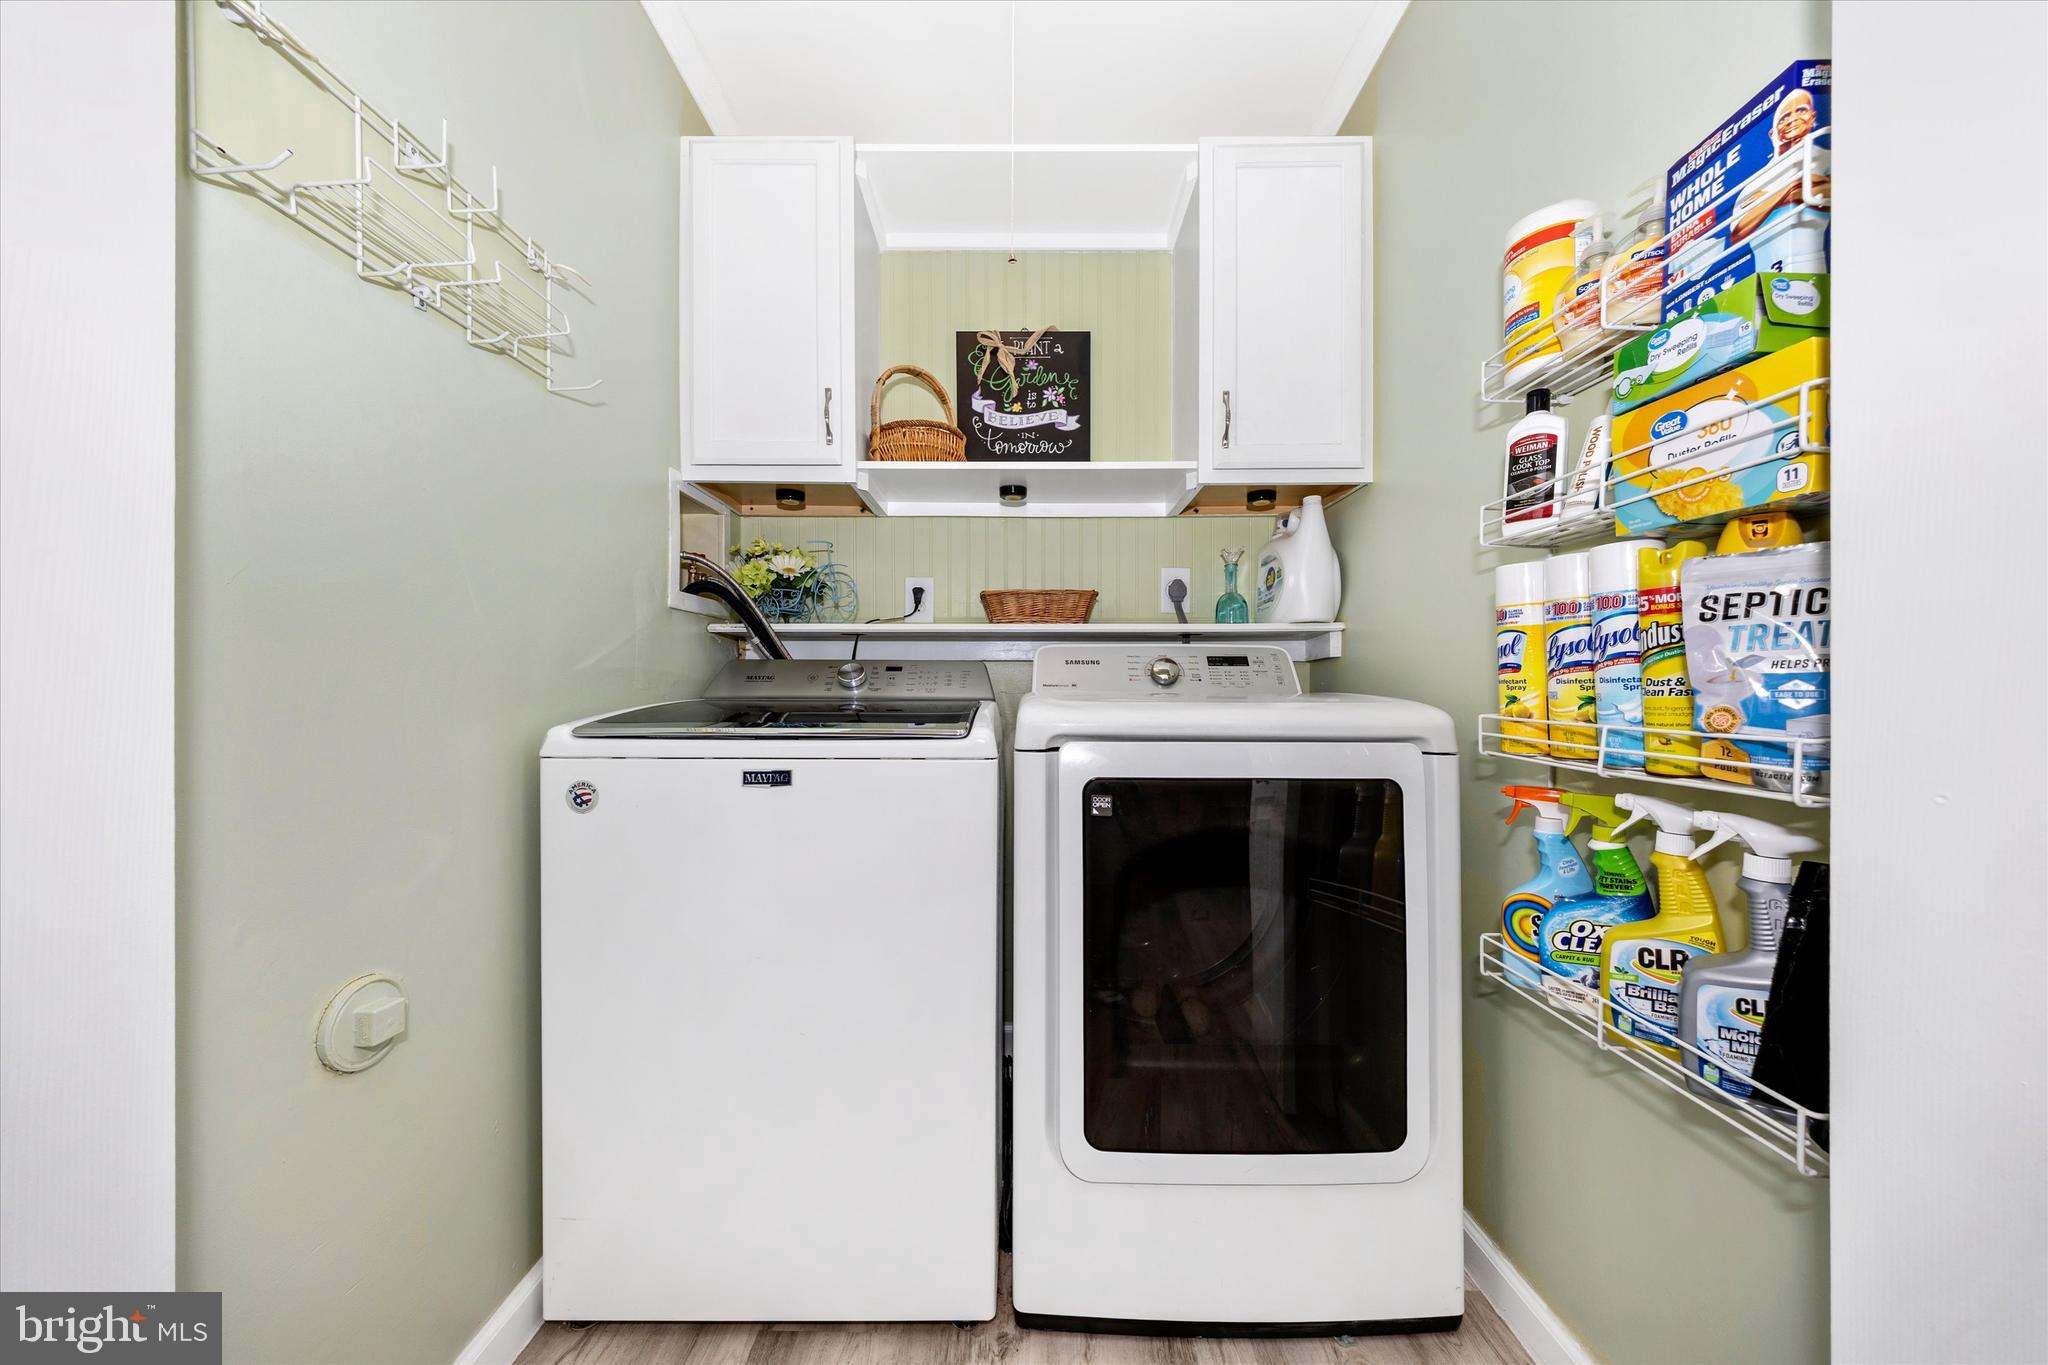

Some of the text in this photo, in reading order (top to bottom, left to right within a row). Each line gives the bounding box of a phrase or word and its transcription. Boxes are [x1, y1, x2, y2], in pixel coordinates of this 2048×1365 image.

[1670, 144, 1741, 214] WHOLE
[1670, 175, 1725, 232] HOME
[1053, 343, 1064, 355] a
[1650, 333, 1698, 362] Dry Sweeping
[1677, 342, 1698, 356] Refills
[1027, 389, 1037, 400] is
[1026, 400, 1037, 409] to
[987, 411, 1060, 427] BELIEVE
[1655, 415, 1682, 432] Great
[976, 422, 1072, 455] tomorrow
[1586, 426, 1603, 457] WOOD
[1515, 441, 1549, 454] WEIMAN
[1512, 458, 1551, 472] COOK TOP
[1519, 453, 1543, 464] GLASS
[1784, 467, 1798, 481] 11
[1595, 595, 1622, 610] 100
[1699, 586, 1830, 622] SEPTIC
[1771, 657, 1830, 669] HELPS PR
[1600, 676, 1642, 684] Disinfecta
[1646, 677, 1687, 687] Dust &
[1623, 684, 1640, 692] Spr
[1720, 745, 1733, 758] 12
[745, 773, 789, 783] MAYTAG
[569, 781, 597, 795] AMERICA
[1569, 919, 1608, 939] OX
[1552, 931, 1602, 953] CLE
[1689, 935, 1716, 947] TOUGH
[1637, 947, 1689, 971] CLR
[1627, 985, 1678, 1003] Brillia
[1654, 1001, 1678, 1014] Ba
[1735, 997, 1764, 1017] CL
[1720, 1027, 1762, 1045] Mol
[1731, 1041, 1760, 1056] Mil
[1722, 1052, 1749, 1063] FOAMING
